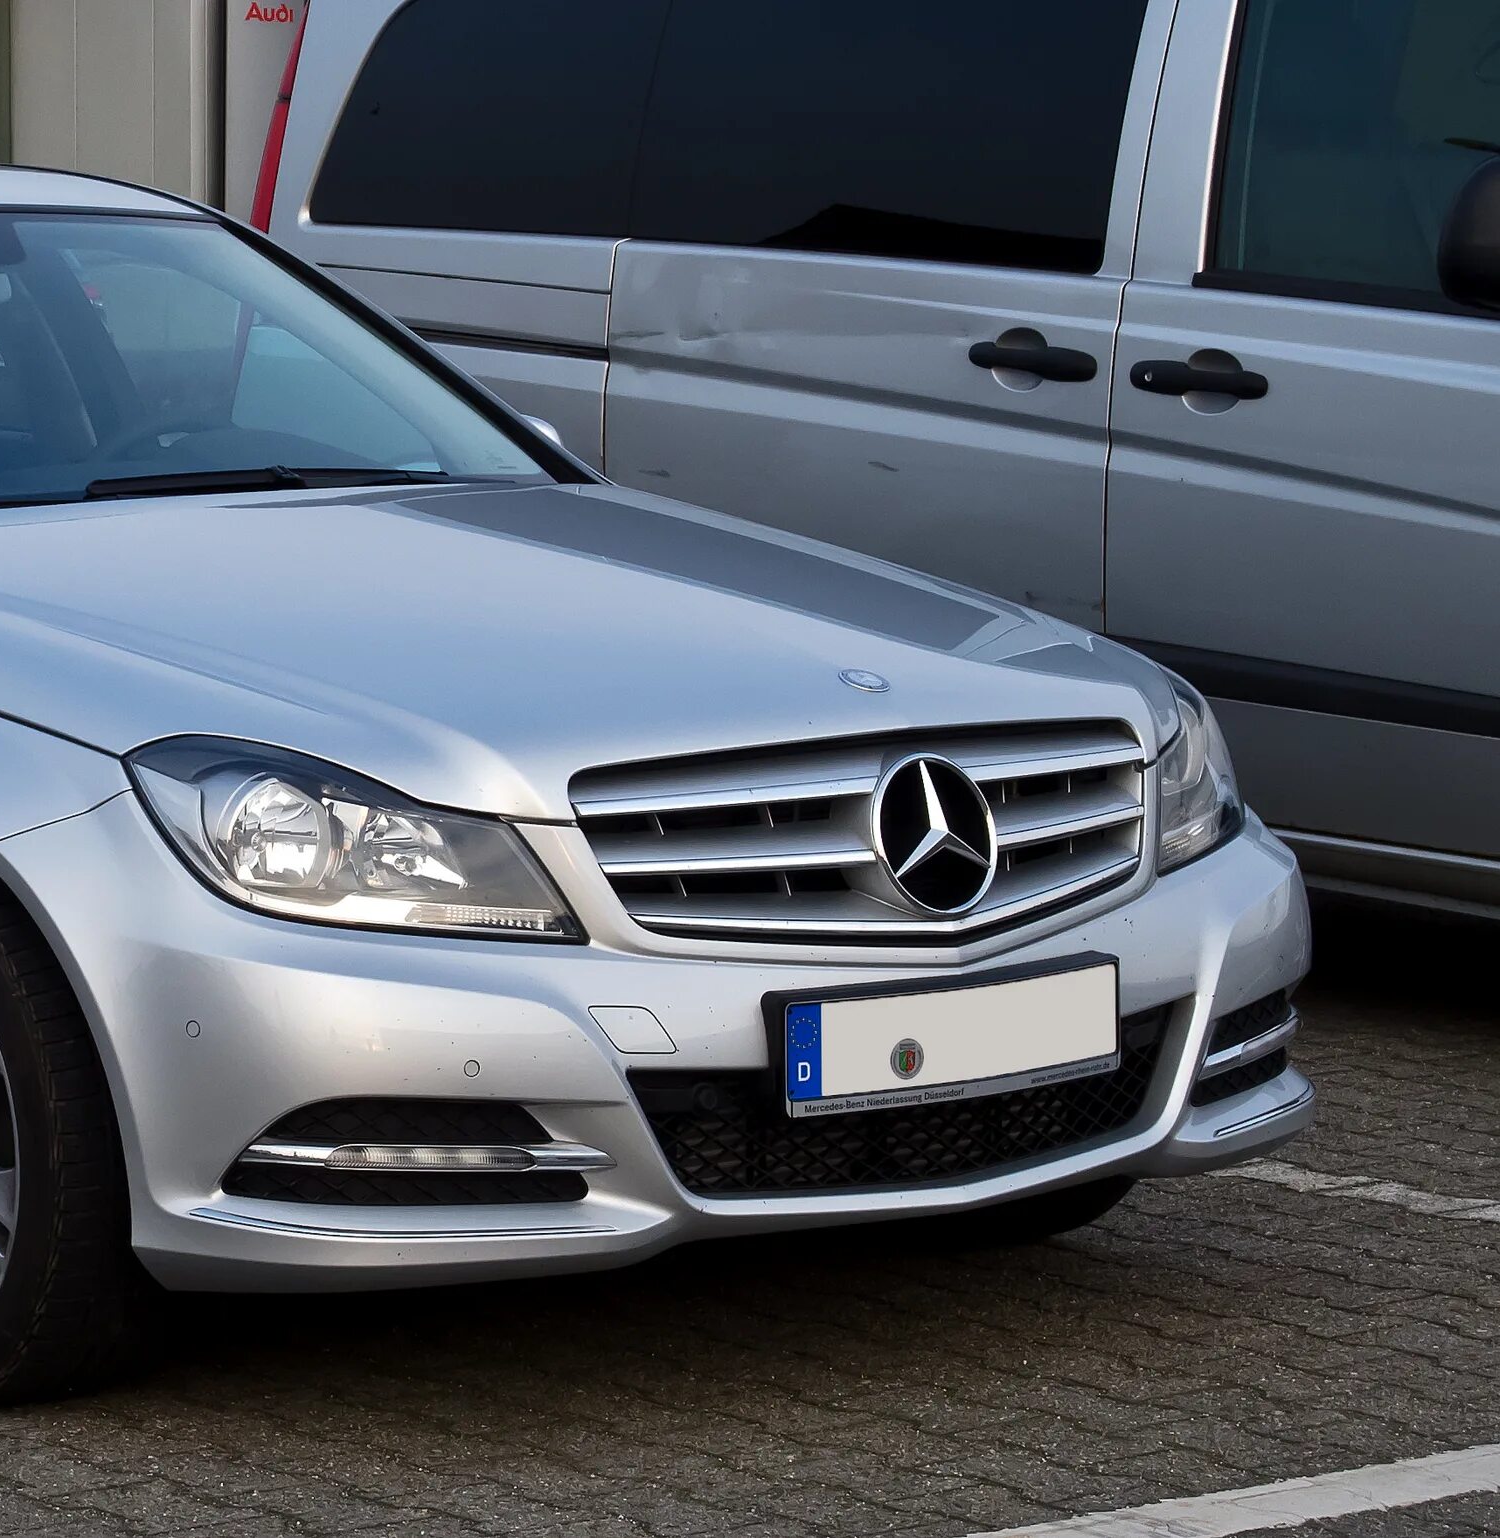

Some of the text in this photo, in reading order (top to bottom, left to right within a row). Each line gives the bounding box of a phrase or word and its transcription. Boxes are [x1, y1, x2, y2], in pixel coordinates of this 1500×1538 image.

[245, 2, 294, 23] Audi
[797, 1061, 811, 1082] D
[804, 1087, 964, 1113] Mercedes-Benz Niederlassung Düsseldorf
